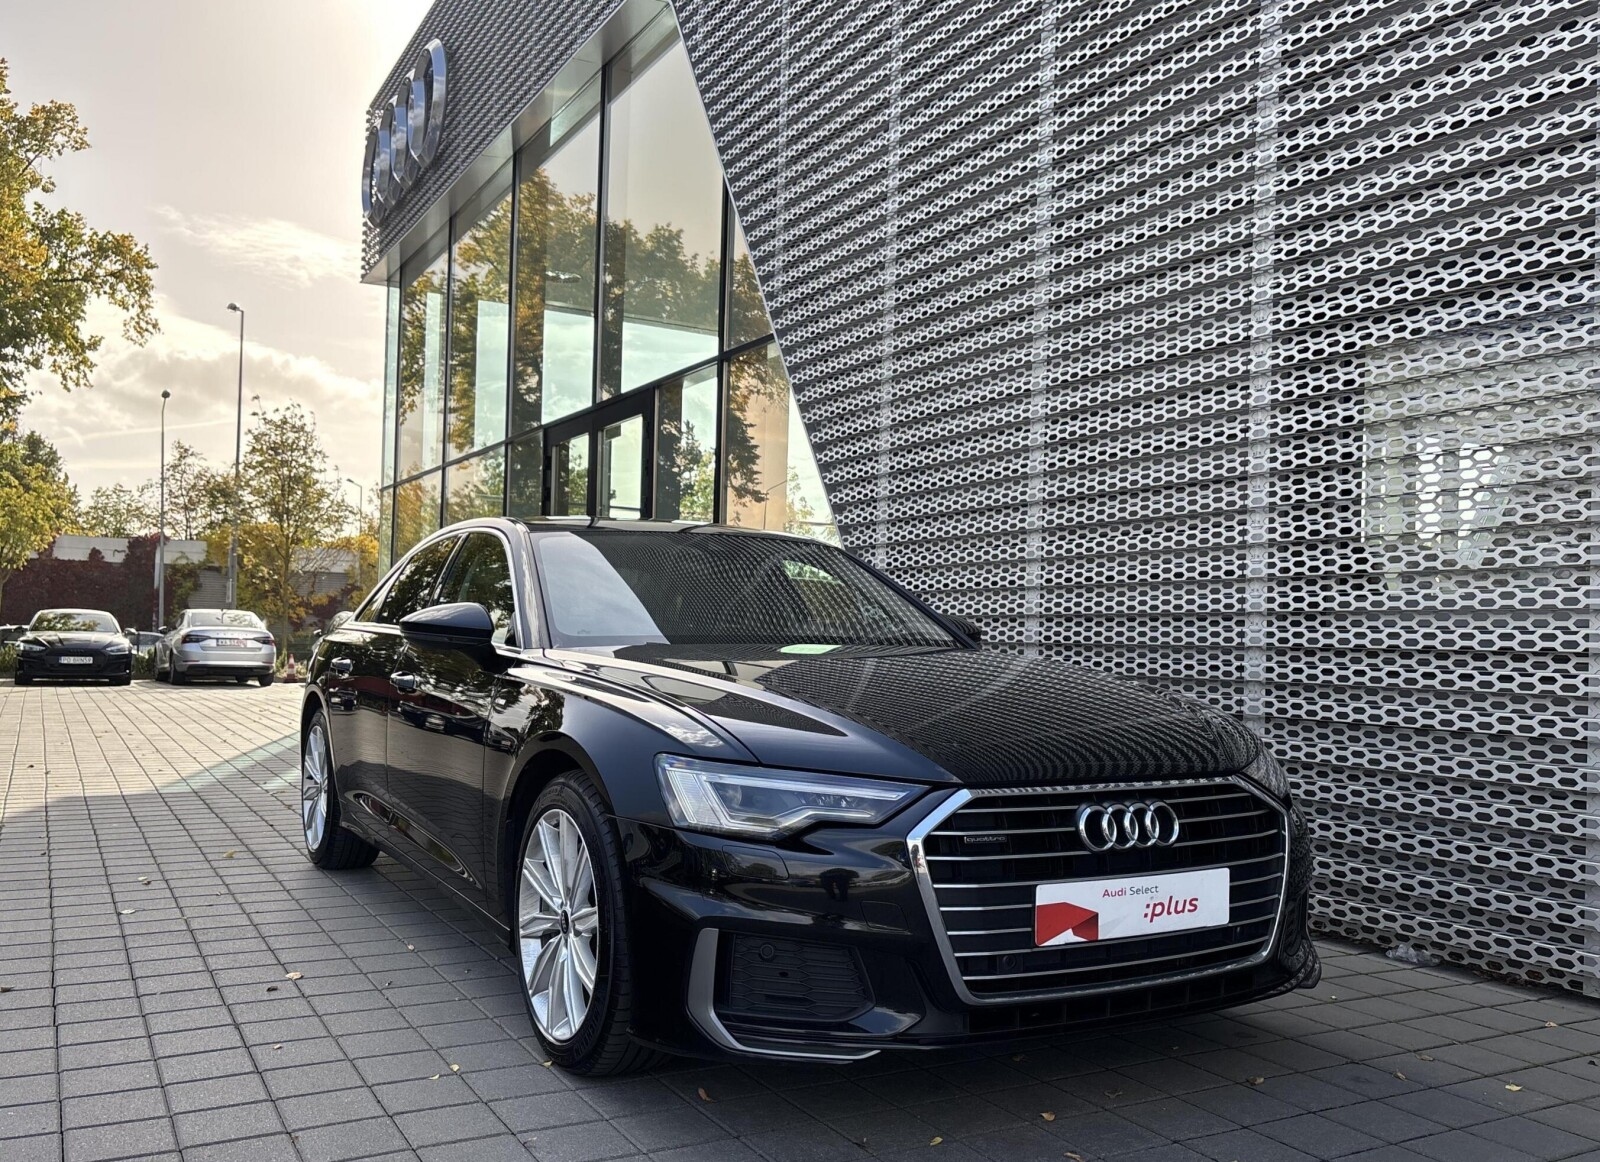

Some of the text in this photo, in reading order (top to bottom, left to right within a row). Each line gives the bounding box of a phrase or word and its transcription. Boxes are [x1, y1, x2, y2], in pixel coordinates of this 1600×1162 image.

[1102, 885, 1159, 898] Audi Select
[1143, 895, 1199, 923] :plus
